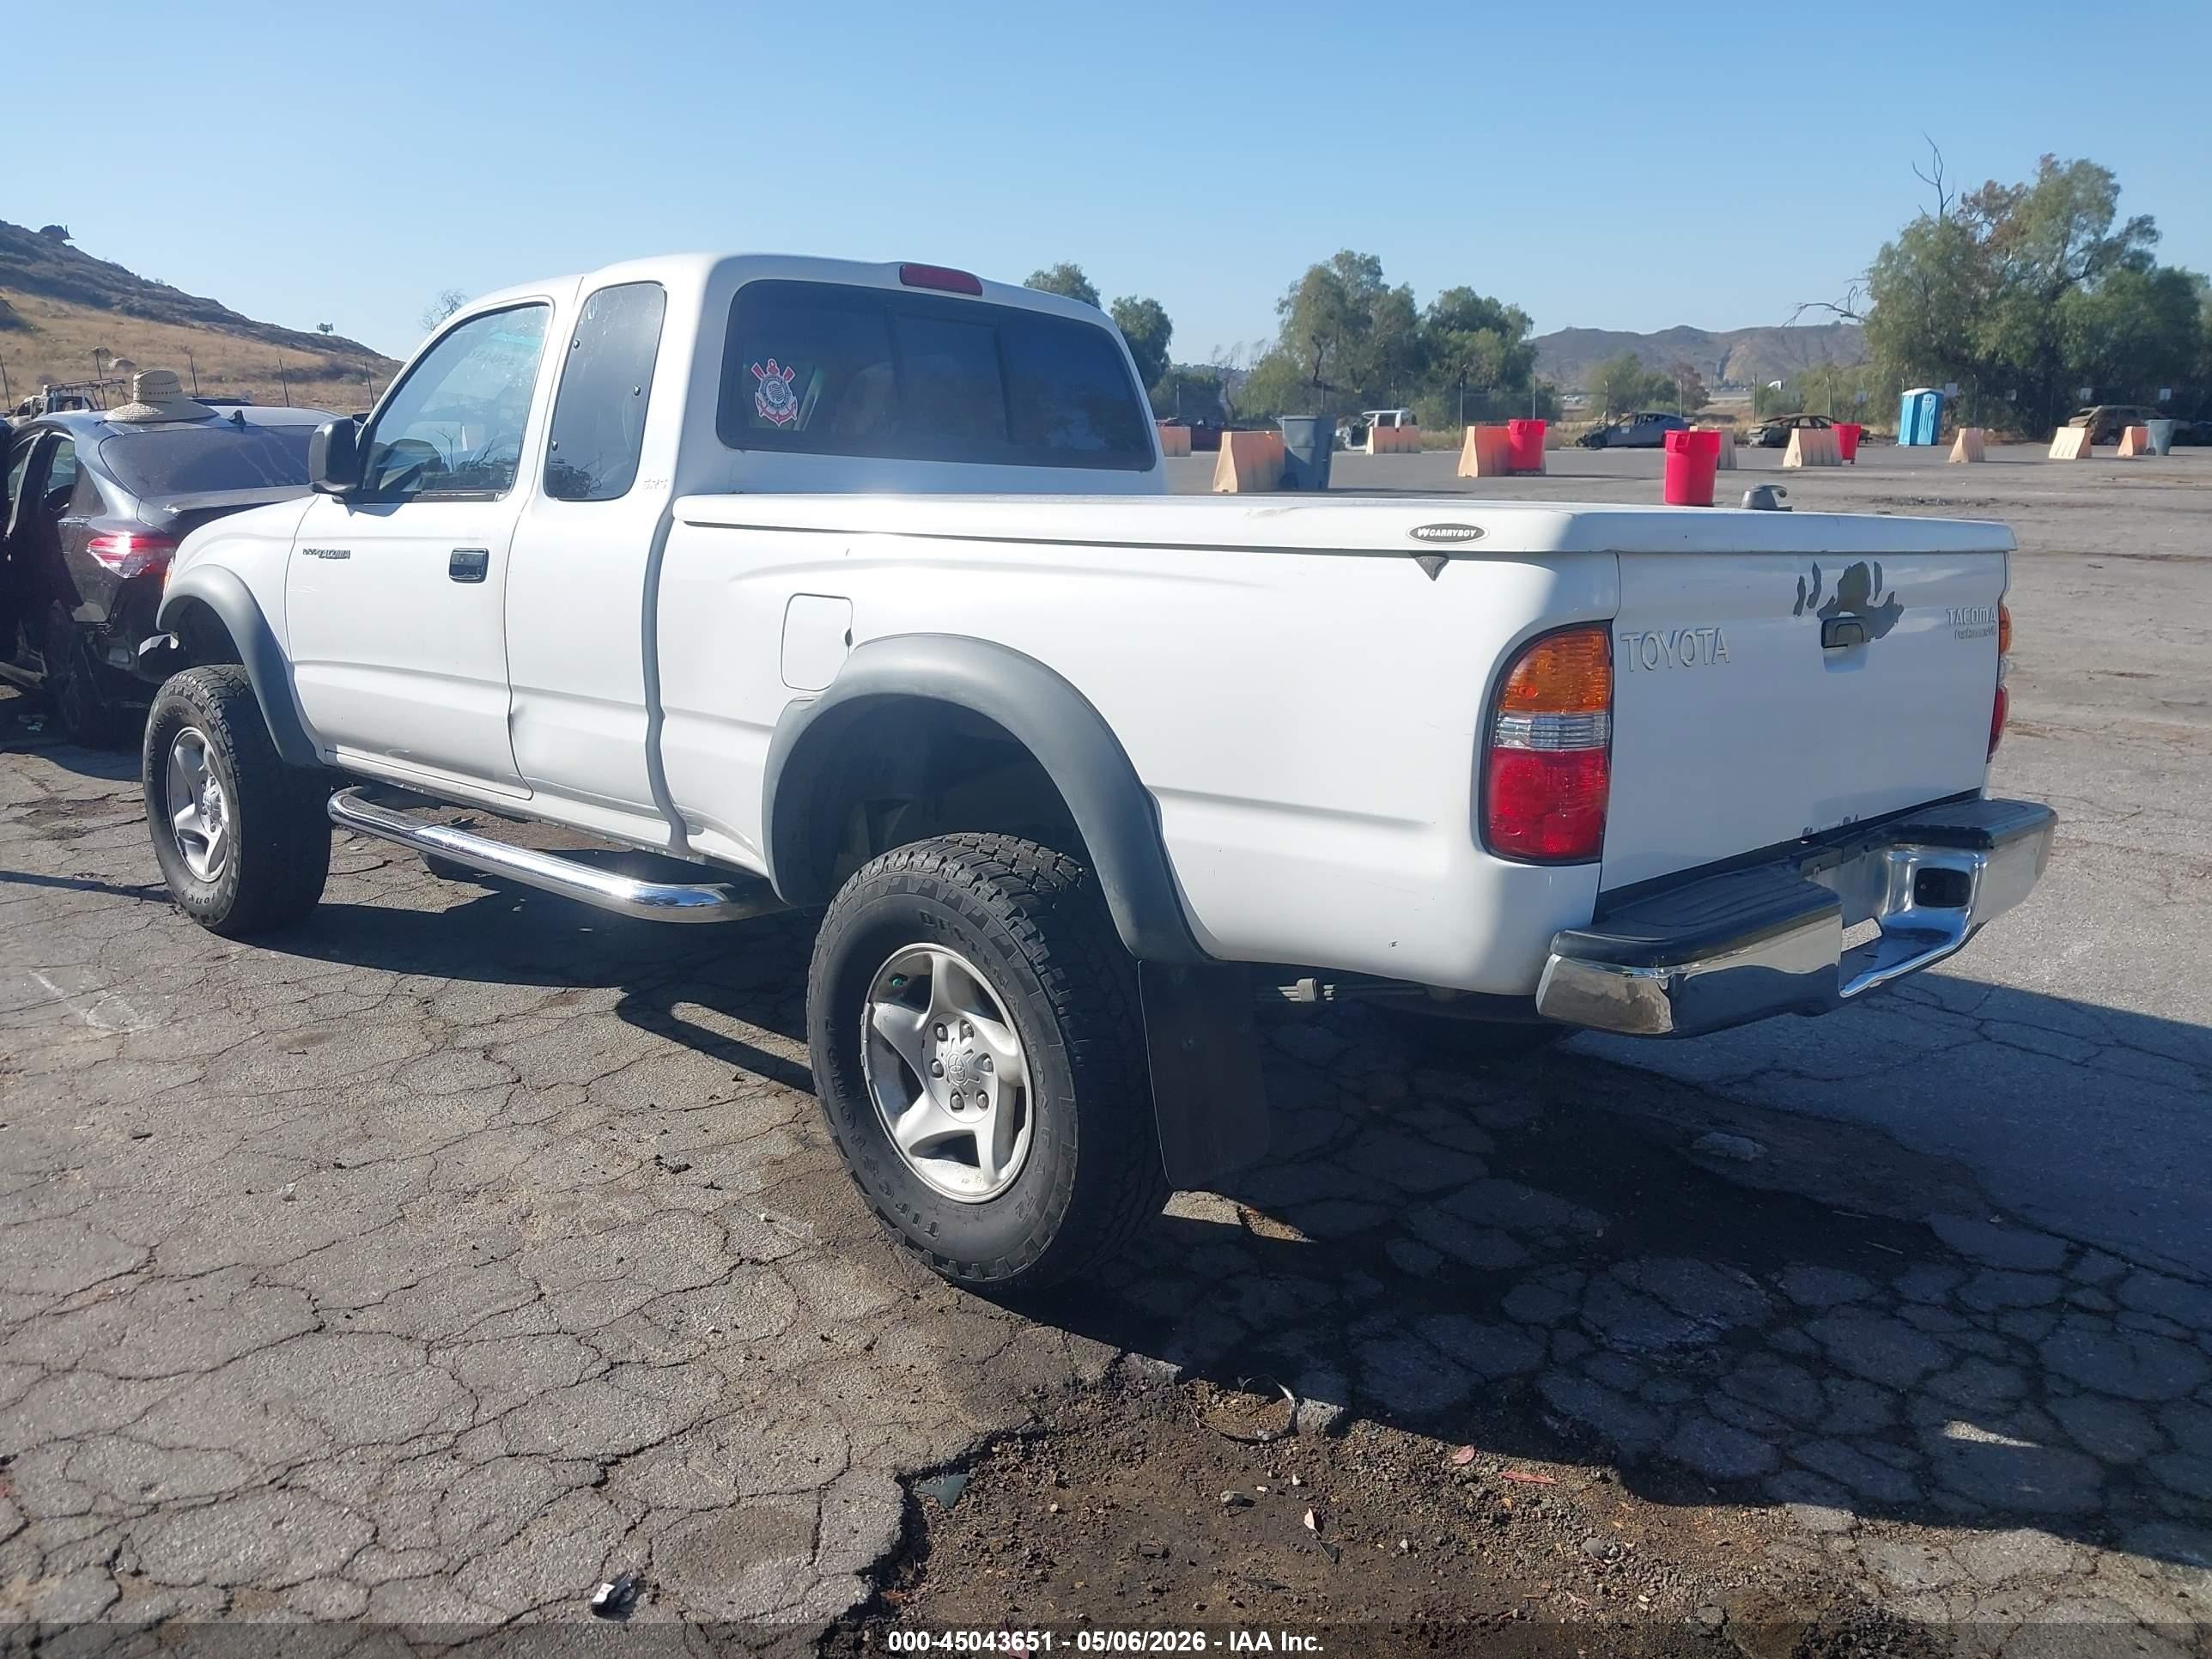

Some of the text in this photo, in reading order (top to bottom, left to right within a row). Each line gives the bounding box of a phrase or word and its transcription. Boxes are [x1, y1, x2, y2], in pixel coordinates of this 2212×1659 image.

[1428, 528, 1477, 538] CARRYBOY
[1946, 607, 1996, 626] TACOMA
[1620, 626, 1730, 672] TOYOTA
